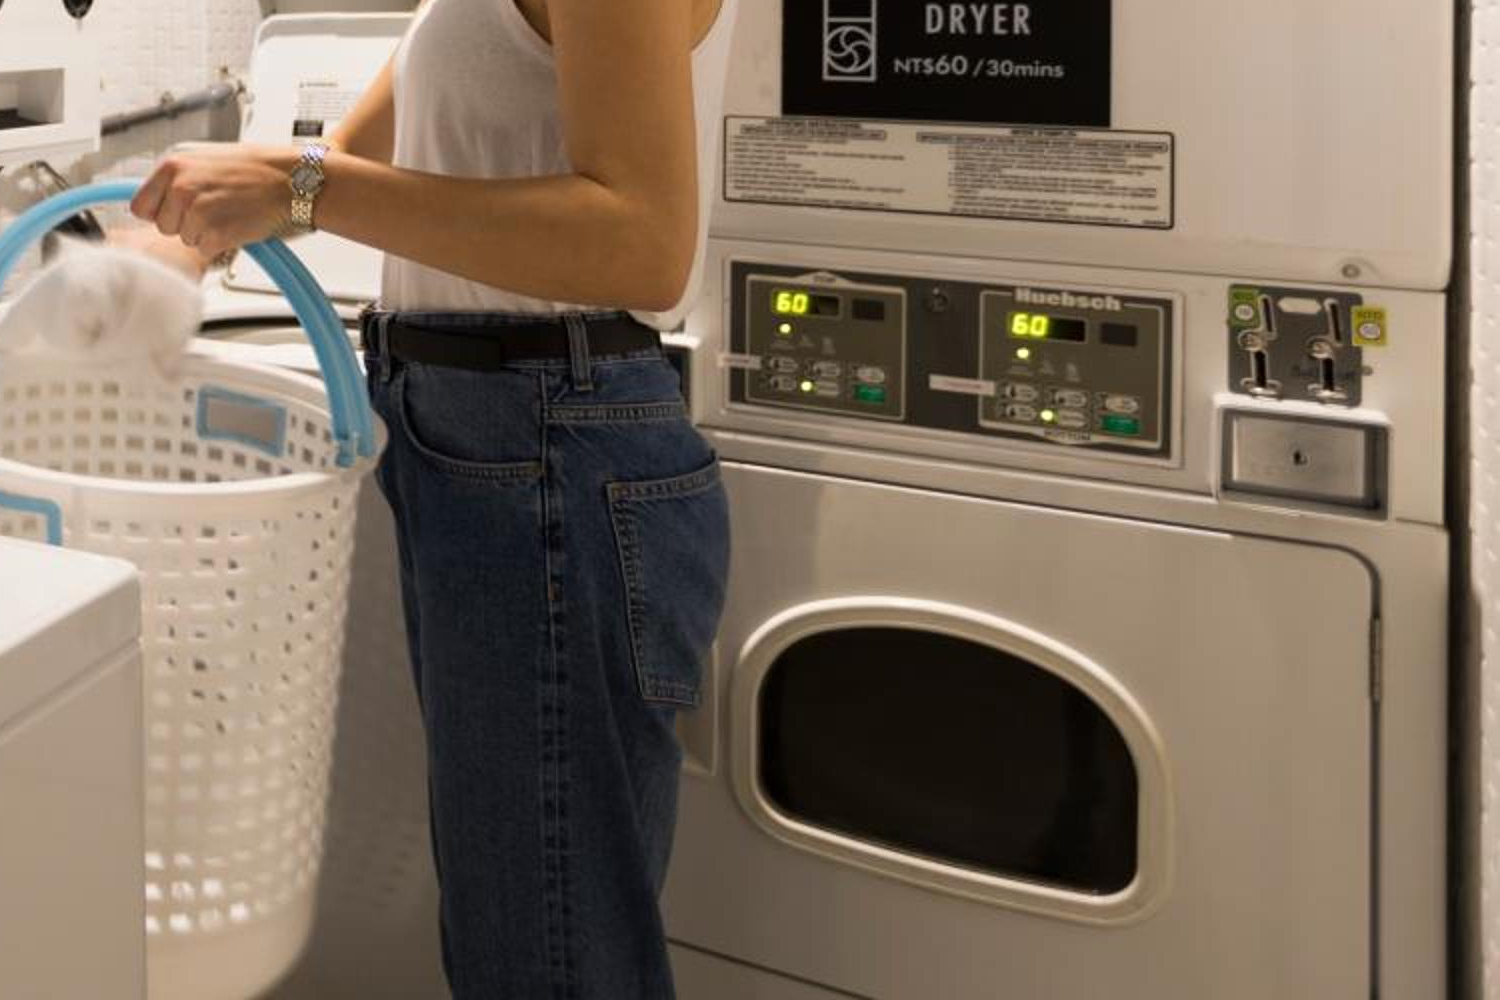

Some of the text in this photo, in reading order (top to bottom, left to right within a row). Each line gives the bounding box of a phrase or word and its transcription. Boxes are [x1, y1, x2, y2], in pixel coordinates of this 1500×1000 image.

[925, 3, 1031, 35] DRYER
[894, 55, 967, 76] NT$60
[776, 292, 808, 314] 60
[1015, 286, 1122, 311] Huebsch
[1012, 313, 1048, 337] 60
